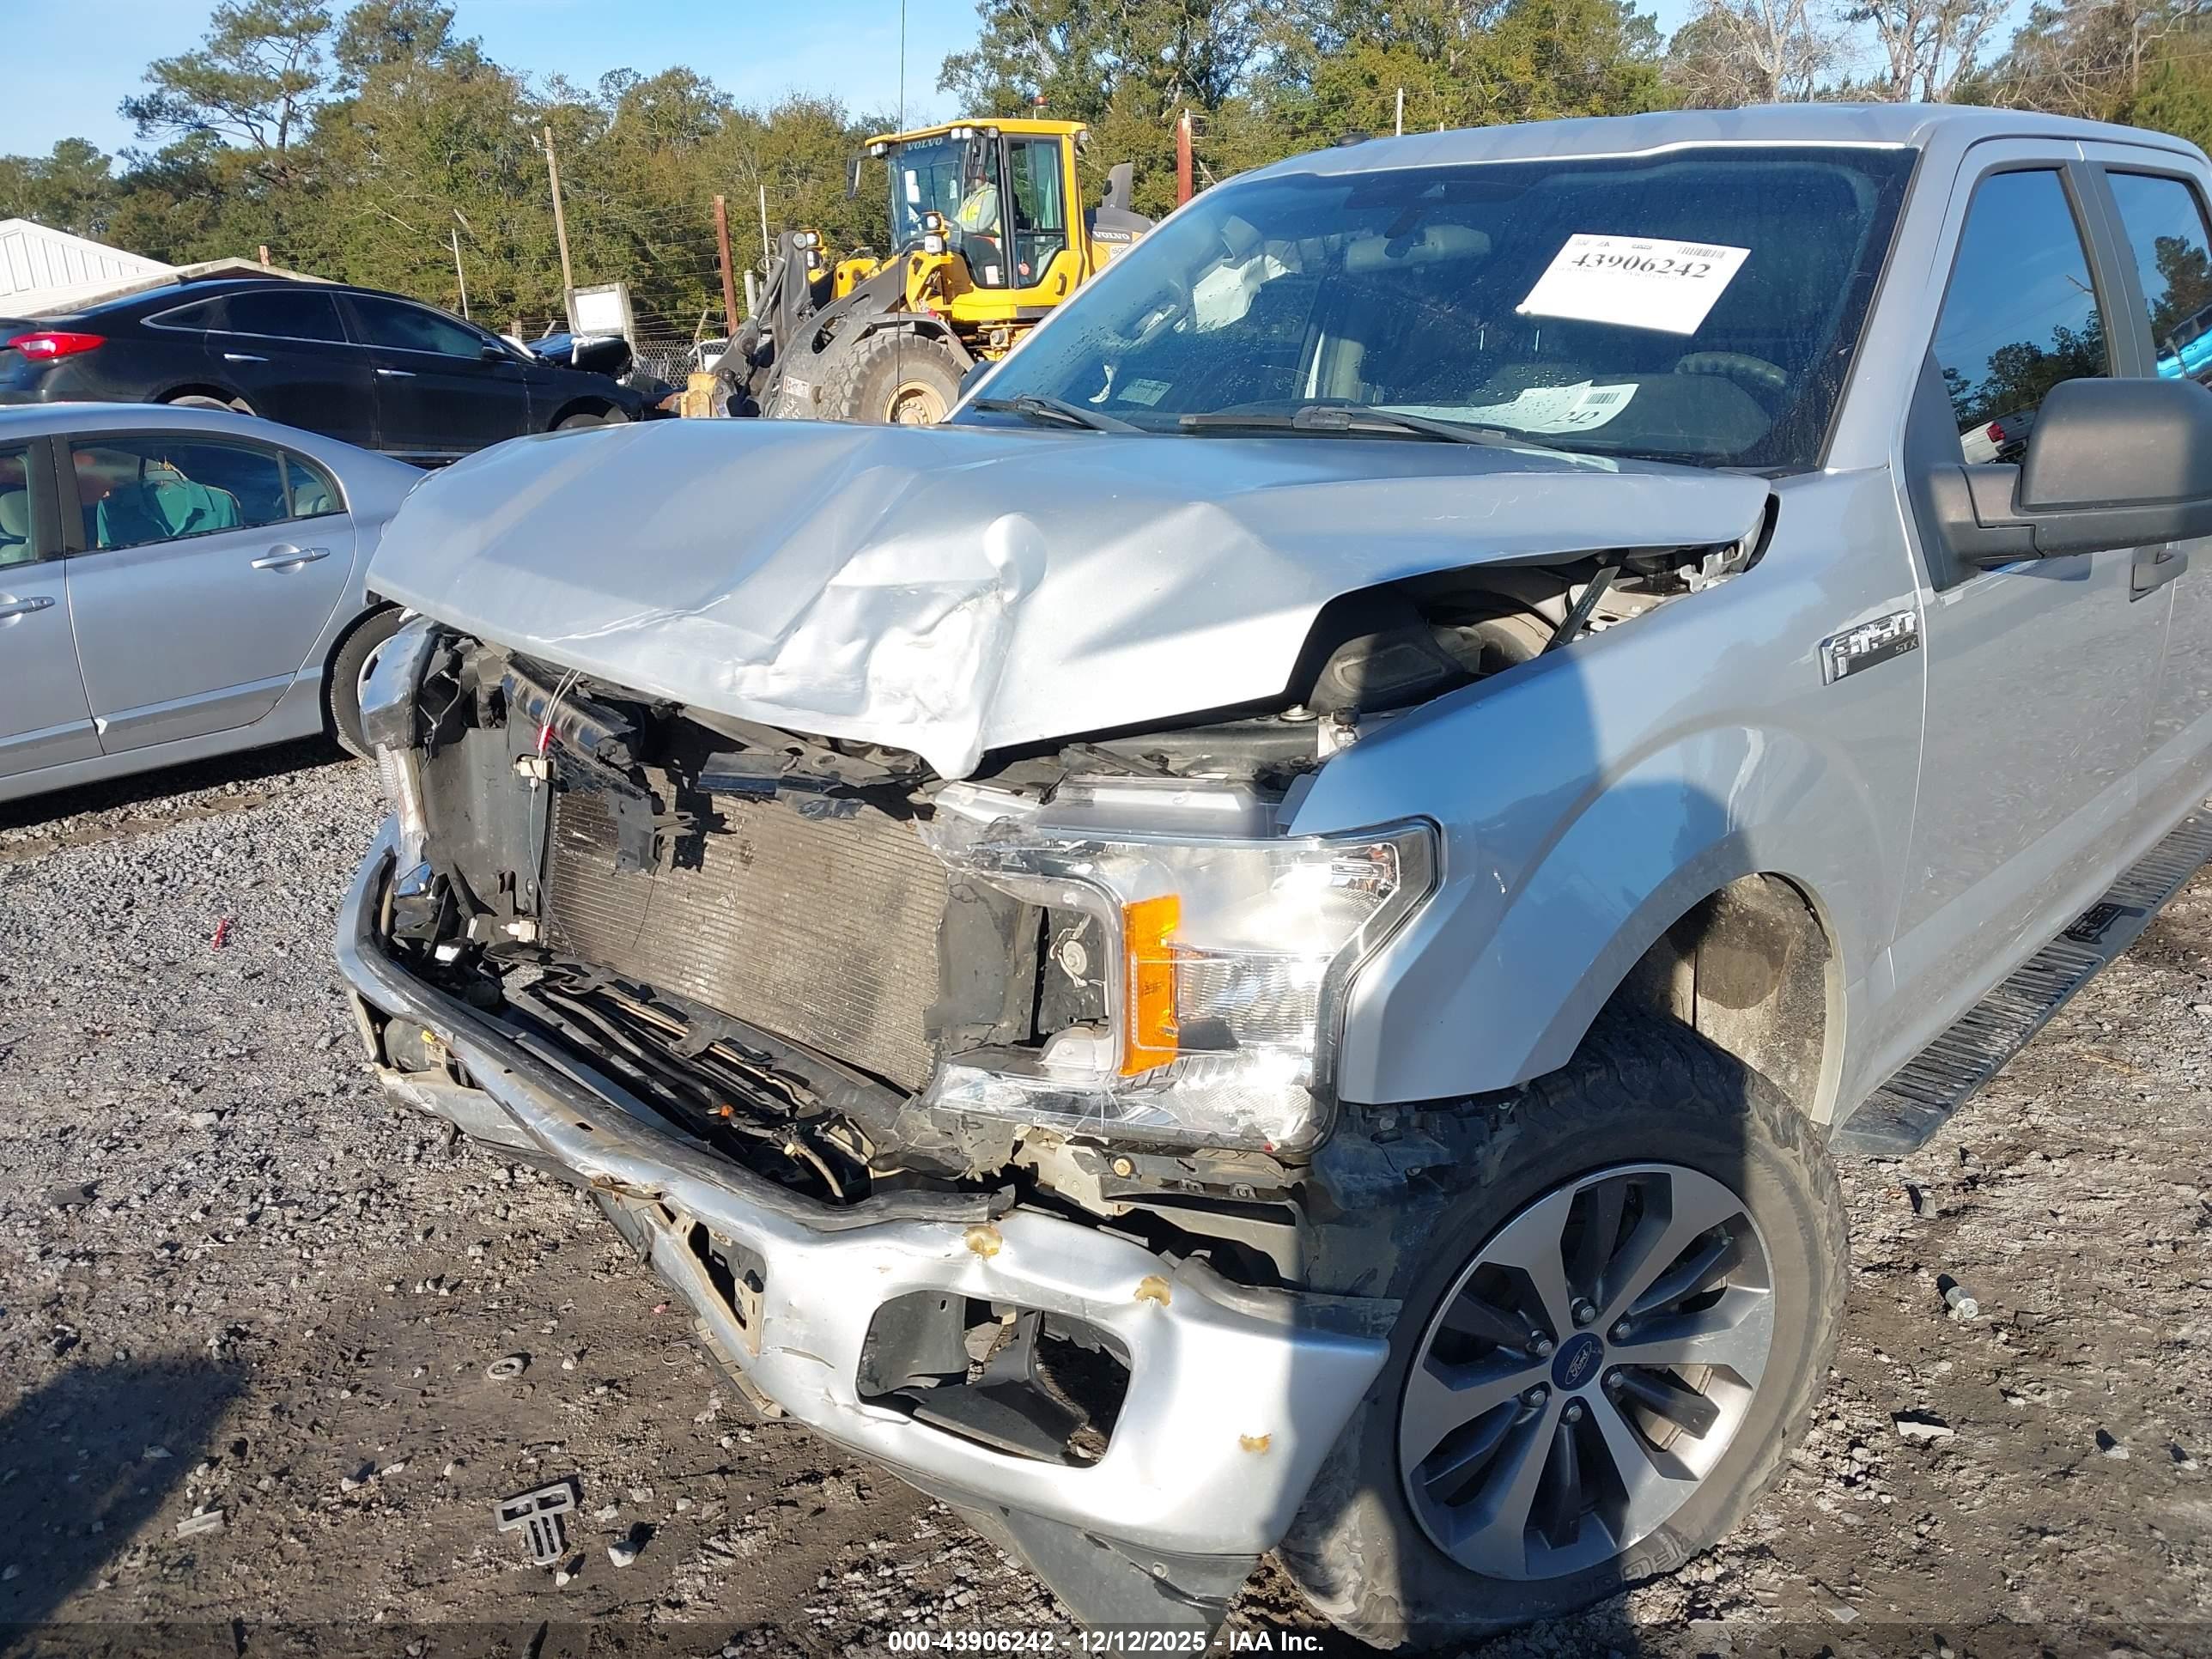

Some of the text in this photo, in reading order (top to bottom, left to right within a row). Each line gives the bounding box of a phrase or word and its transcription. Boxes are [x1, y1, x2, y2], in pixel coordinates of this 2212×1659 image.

[907, 137, 943, 151] VOLVO
[1092, 230, 1130, 240] VOLVO
[1571, 252, 1711, 278] 43906242
[1895, 637, 1917, 654] STX
[1570, 1349, 1589, 1377] Ford
